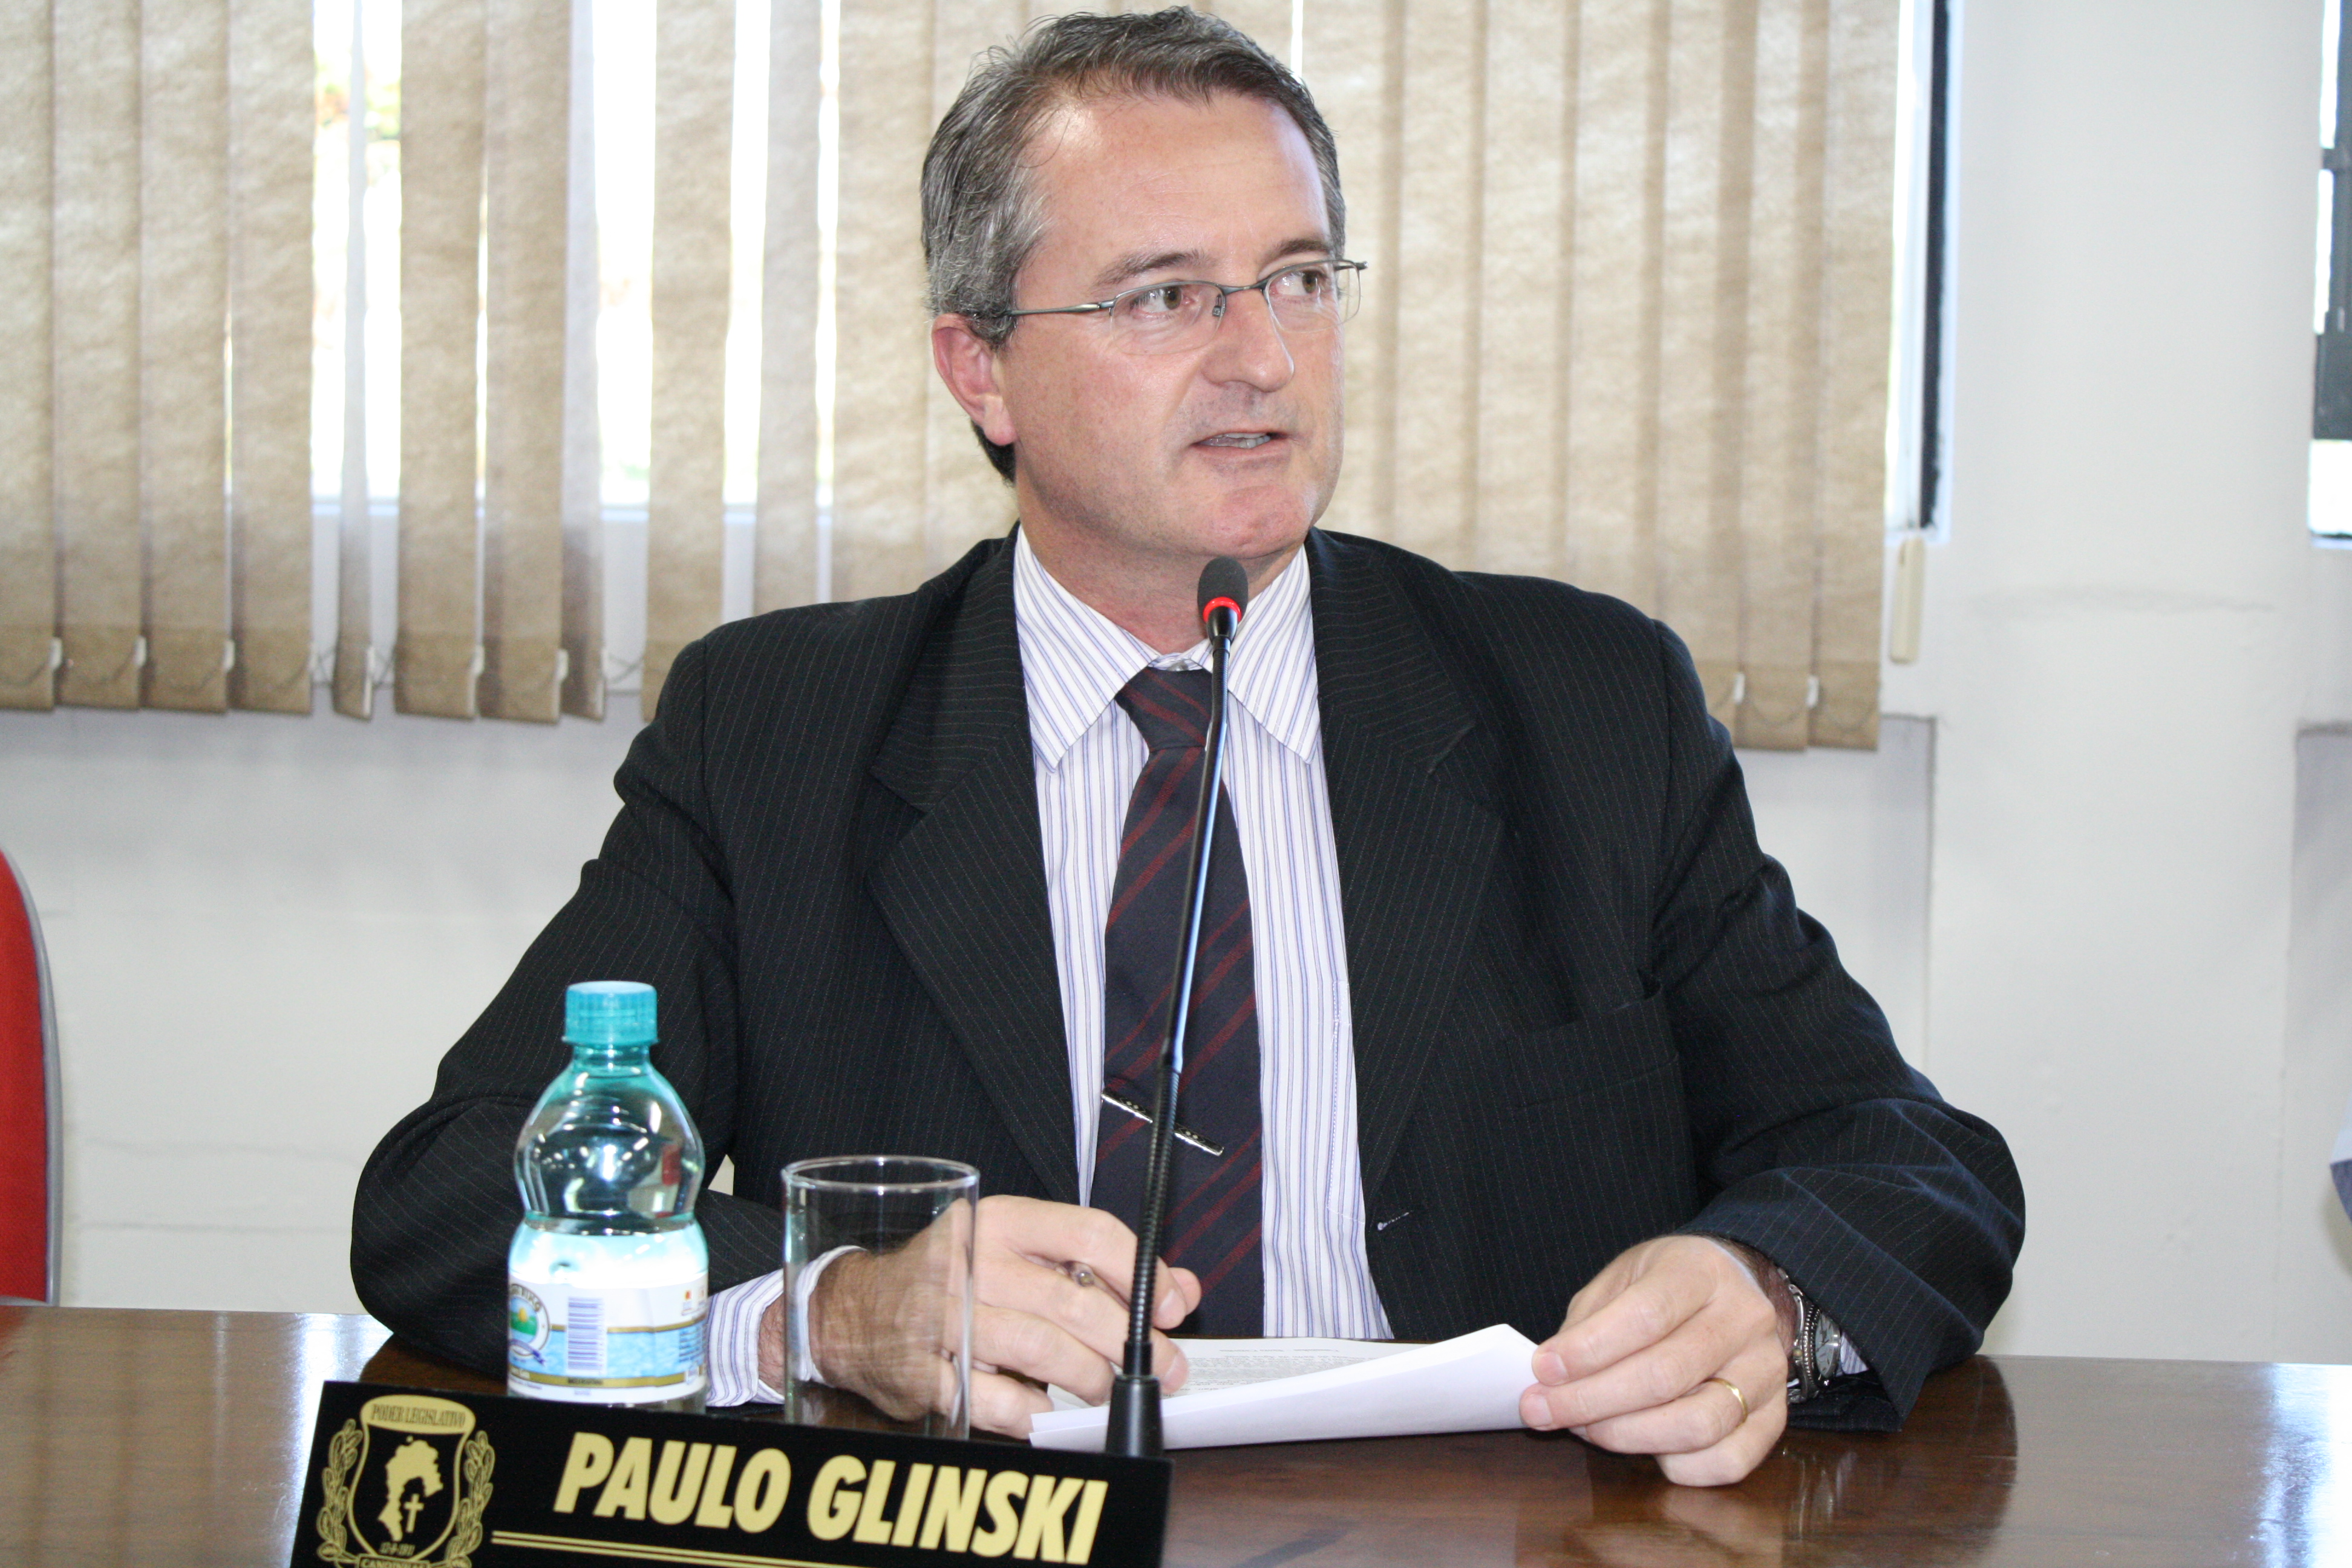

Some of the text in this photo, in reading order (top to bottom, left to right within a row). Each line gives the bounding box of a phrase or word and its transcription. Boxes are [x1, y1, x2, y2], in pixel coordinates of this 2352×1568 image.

[371, 1403, 466, 1429] PODER LEGISLATIVO
[555, 1432, 1108, 1564] PAULO GLINSKI
